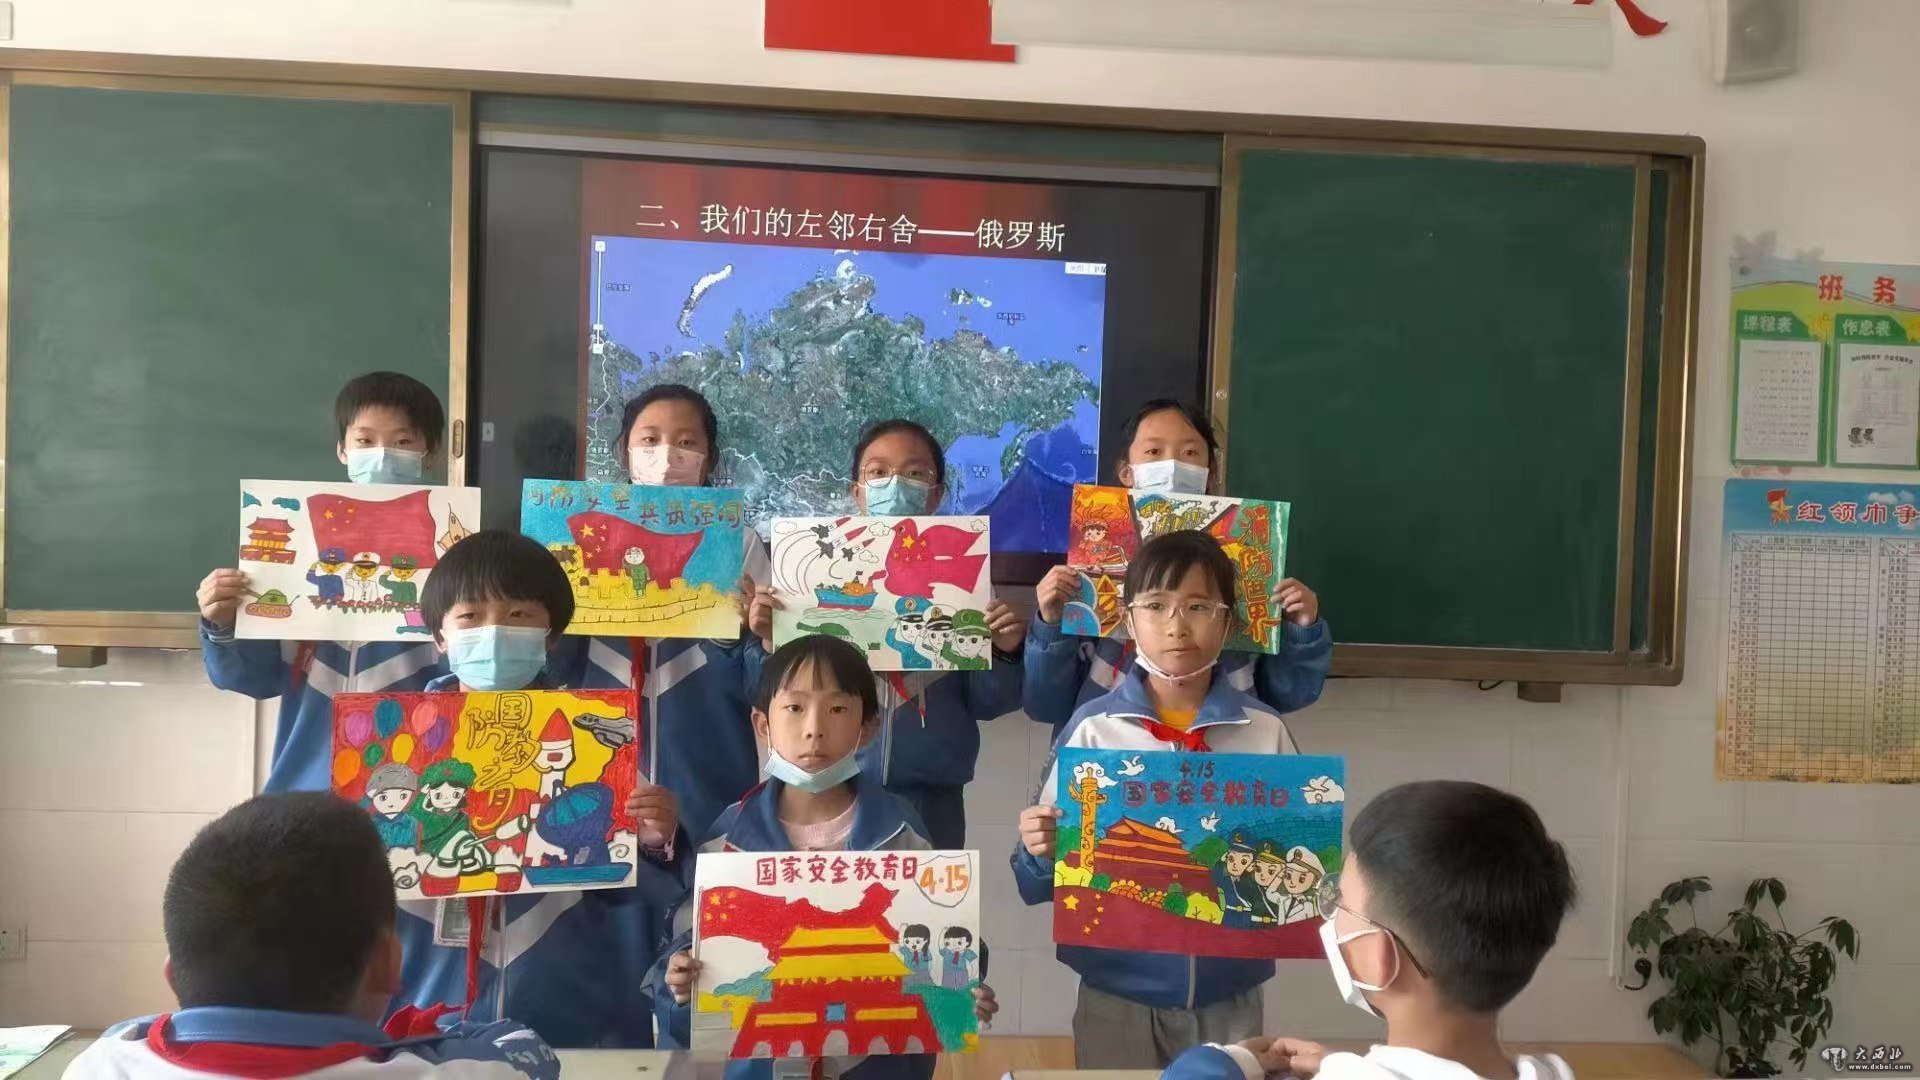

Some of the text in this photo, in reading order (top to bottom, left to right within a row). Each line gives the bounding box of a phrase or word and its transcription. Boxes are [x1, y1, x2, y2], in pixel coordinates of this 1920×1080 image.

[1743, 316, 1793, 332] 课程表
[1842, 320, 1891, 337] 作息表
[1122, 780, 1290, 808] 国家安全教育日
[756, 854, 918, 886] 国家安全教育日
